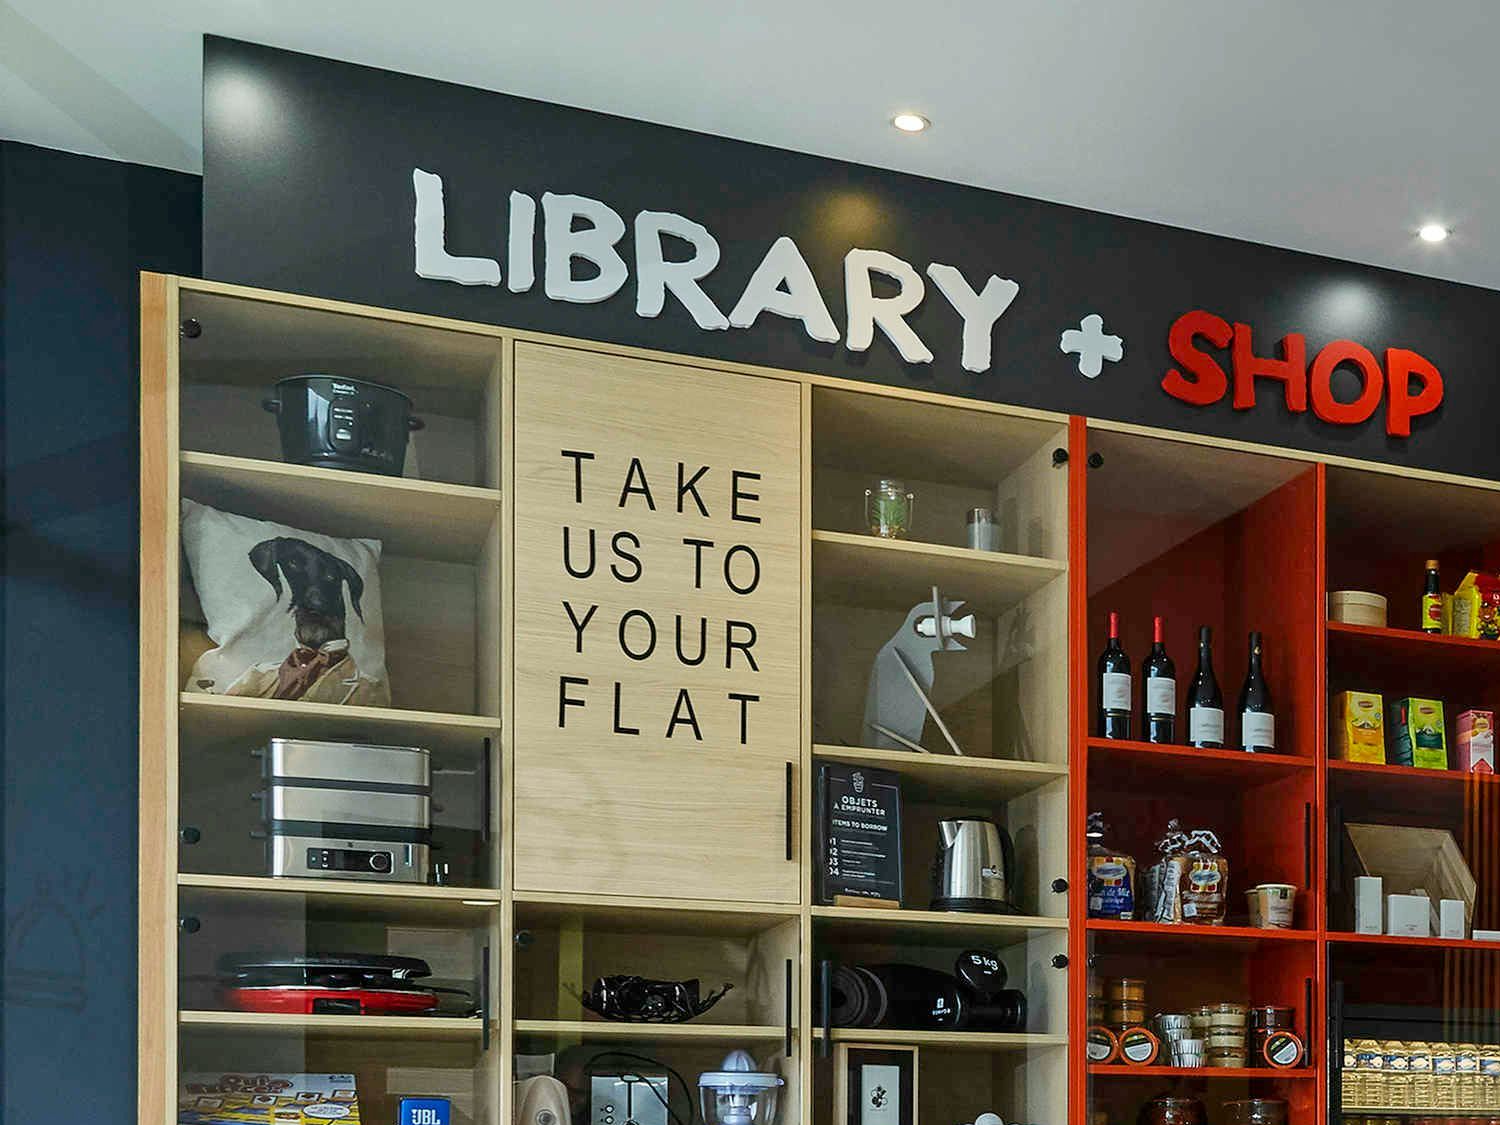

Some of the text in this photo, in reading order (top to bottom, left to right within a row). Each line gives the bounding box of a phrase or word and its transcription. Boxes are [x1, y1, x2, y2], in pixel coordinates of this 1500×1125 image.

[412, 167, 1021, 374] LIBRARY
[1160, 308, 1445, 438] SHOP
[561, 450, 762, 524] TAKE
[563, 527, 761, 596] US TO
[562, 600, 760, 672] YOUR
[560, 676, 762, 745] FLAT
[841, 796, 878, 808] OBJETS
[841, 804, 886, 816] EMPRUNTER
[411, 1108, 441, 1125] JBL
